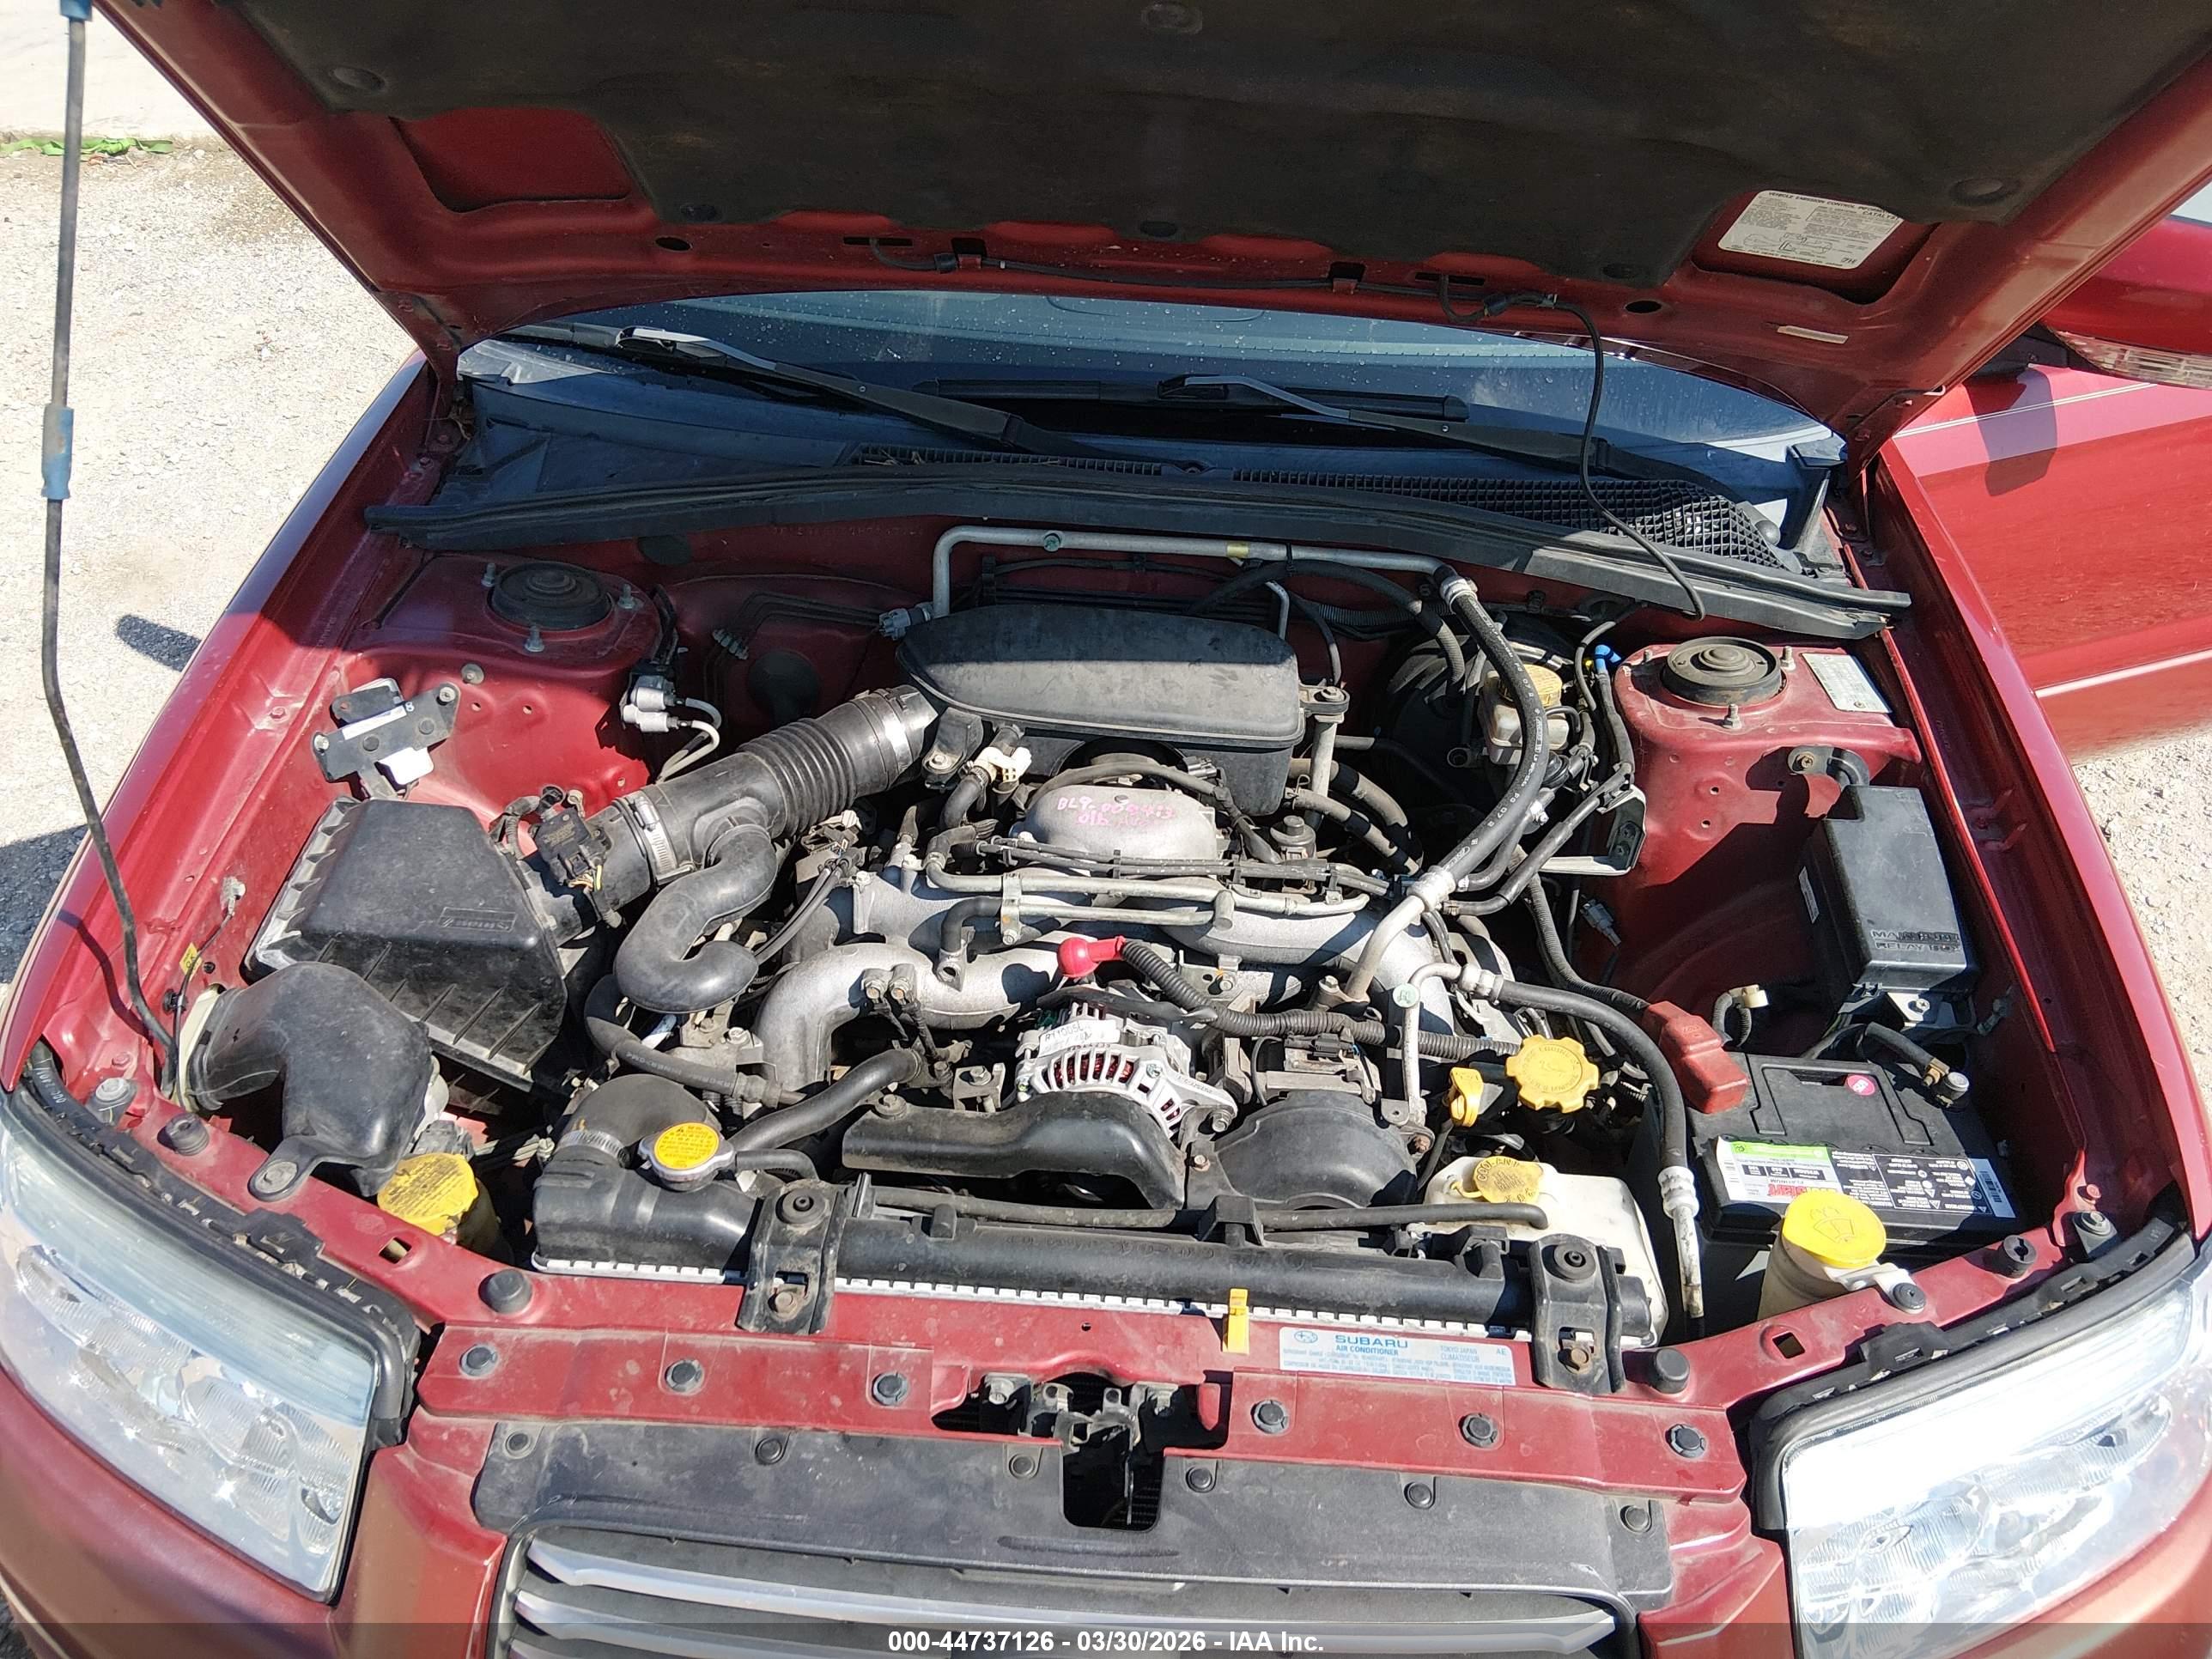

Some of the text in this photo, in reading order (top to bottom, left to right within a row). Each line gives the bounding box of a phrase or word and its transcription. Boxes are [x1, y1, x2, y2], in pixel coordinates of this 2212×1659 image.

[1768, 191, 1794, 200] VEHICLE
[1826, 200, 1856, 209] CONTROL
[1875, 941, 1924, 951] RELAY
[1334, 1334, 1408, 1348] SUBARU
[1350, 1346, 1399, 1356] CONDITIONER
[1441, 1353, 1480, 1362] CLIMATISEUR
